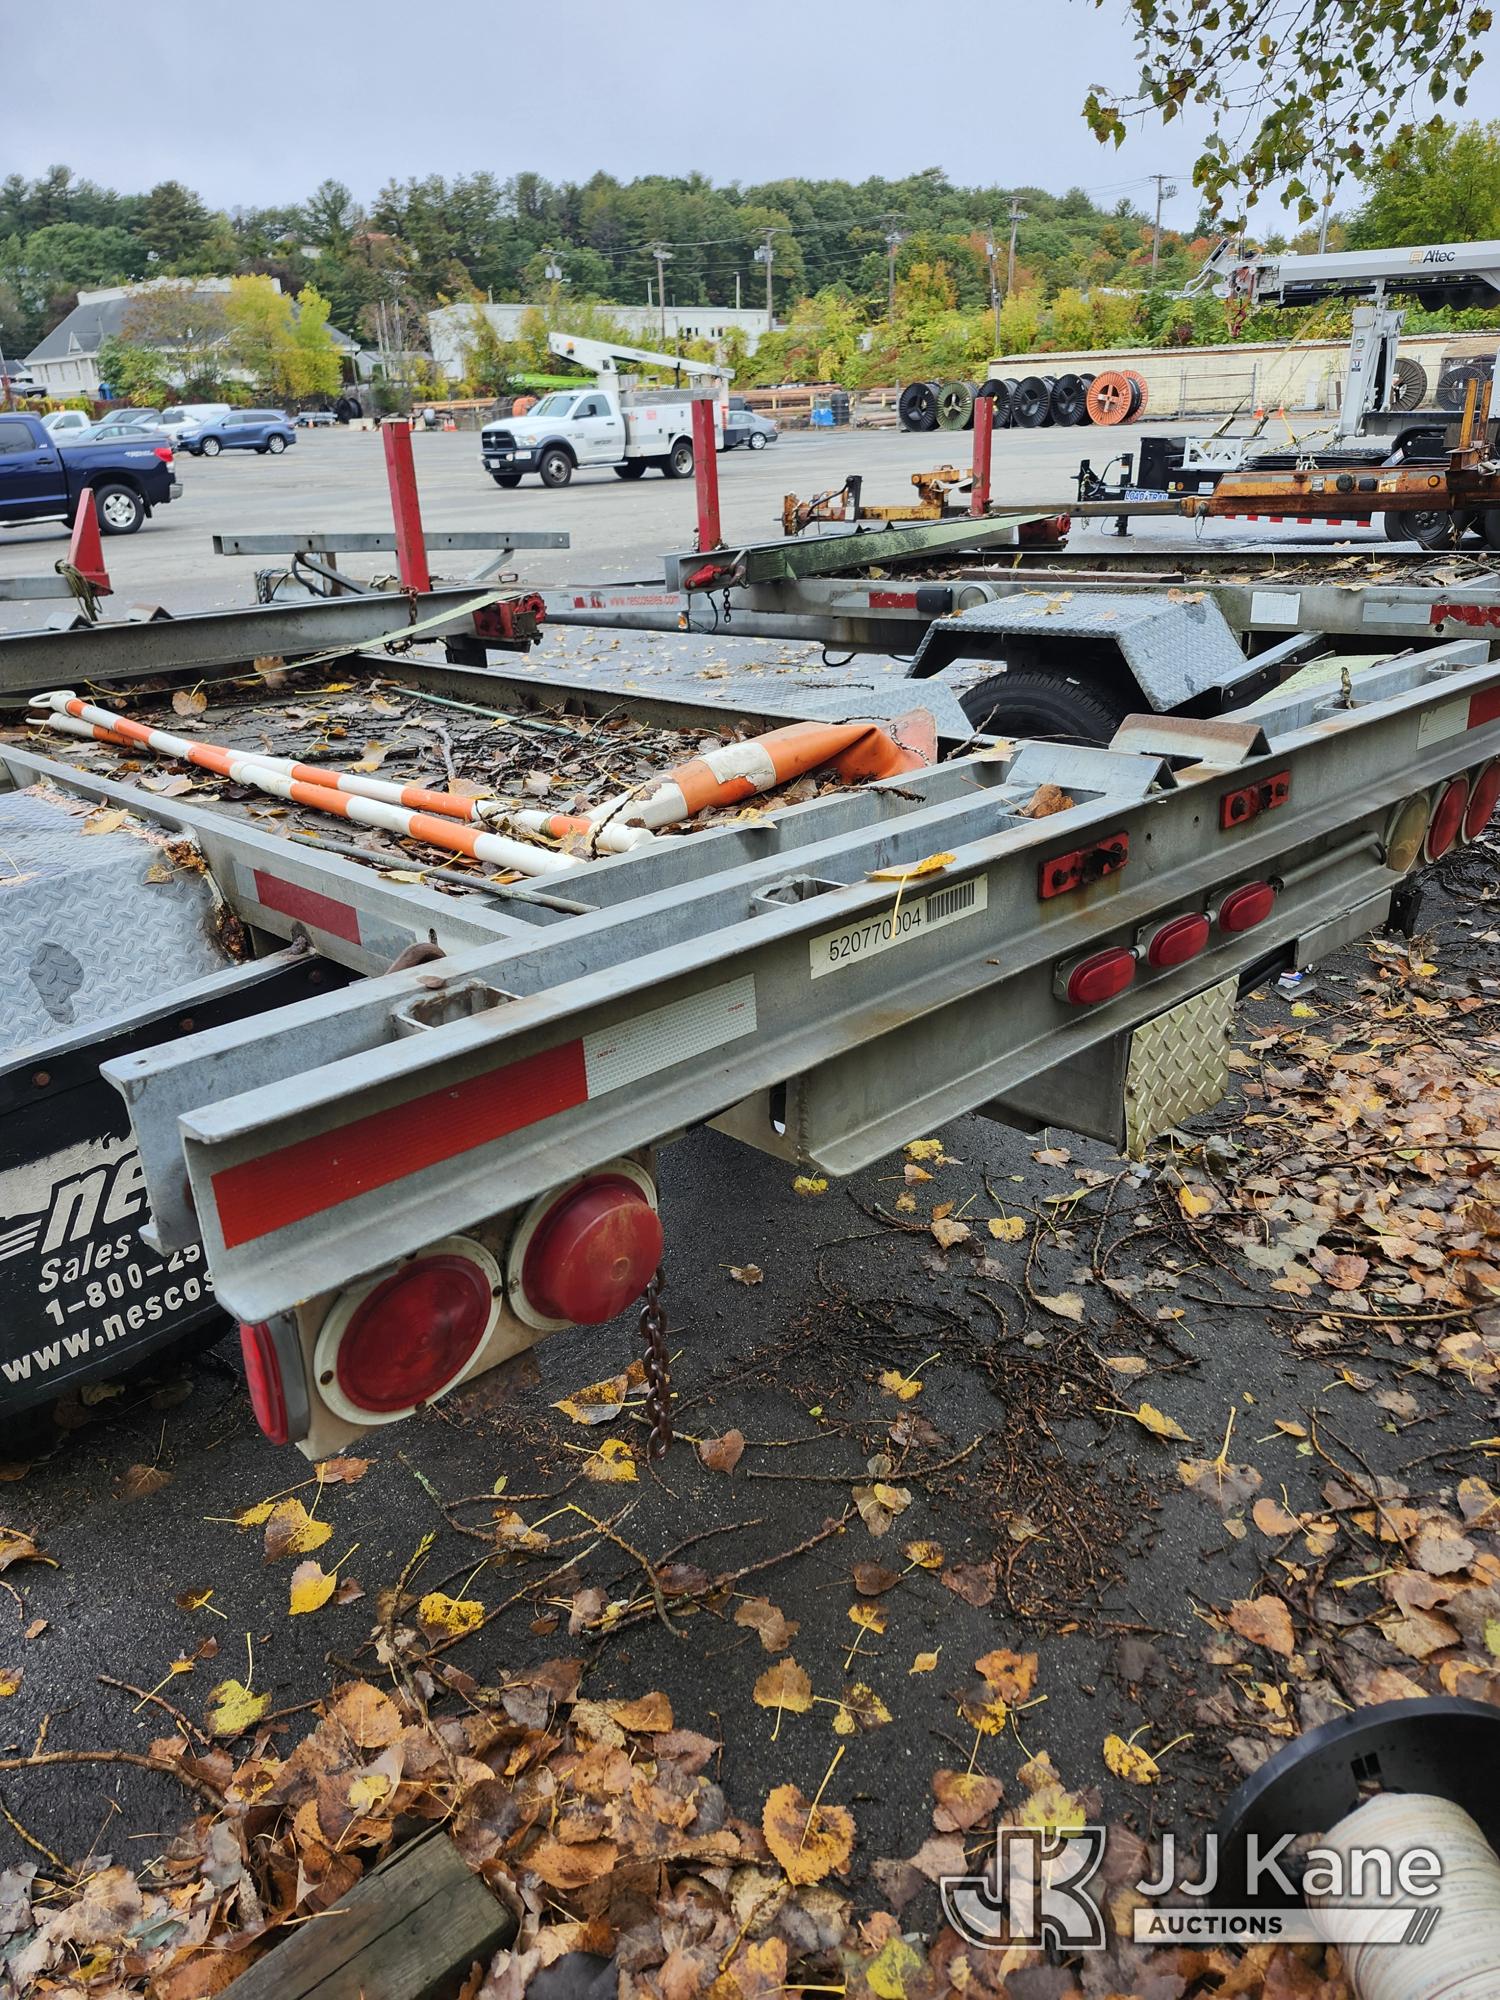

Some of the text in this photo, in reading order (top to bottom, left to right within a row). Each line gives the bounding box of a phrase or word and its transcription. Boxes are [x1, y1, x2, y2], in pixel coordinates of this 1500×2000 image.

[1423, 249, 1456, 264] Altec
[829, 906, 922, 961] 520770004
[41, 1151, 151, 1255] ne
[38, 1234, 132, 1293] Sales
